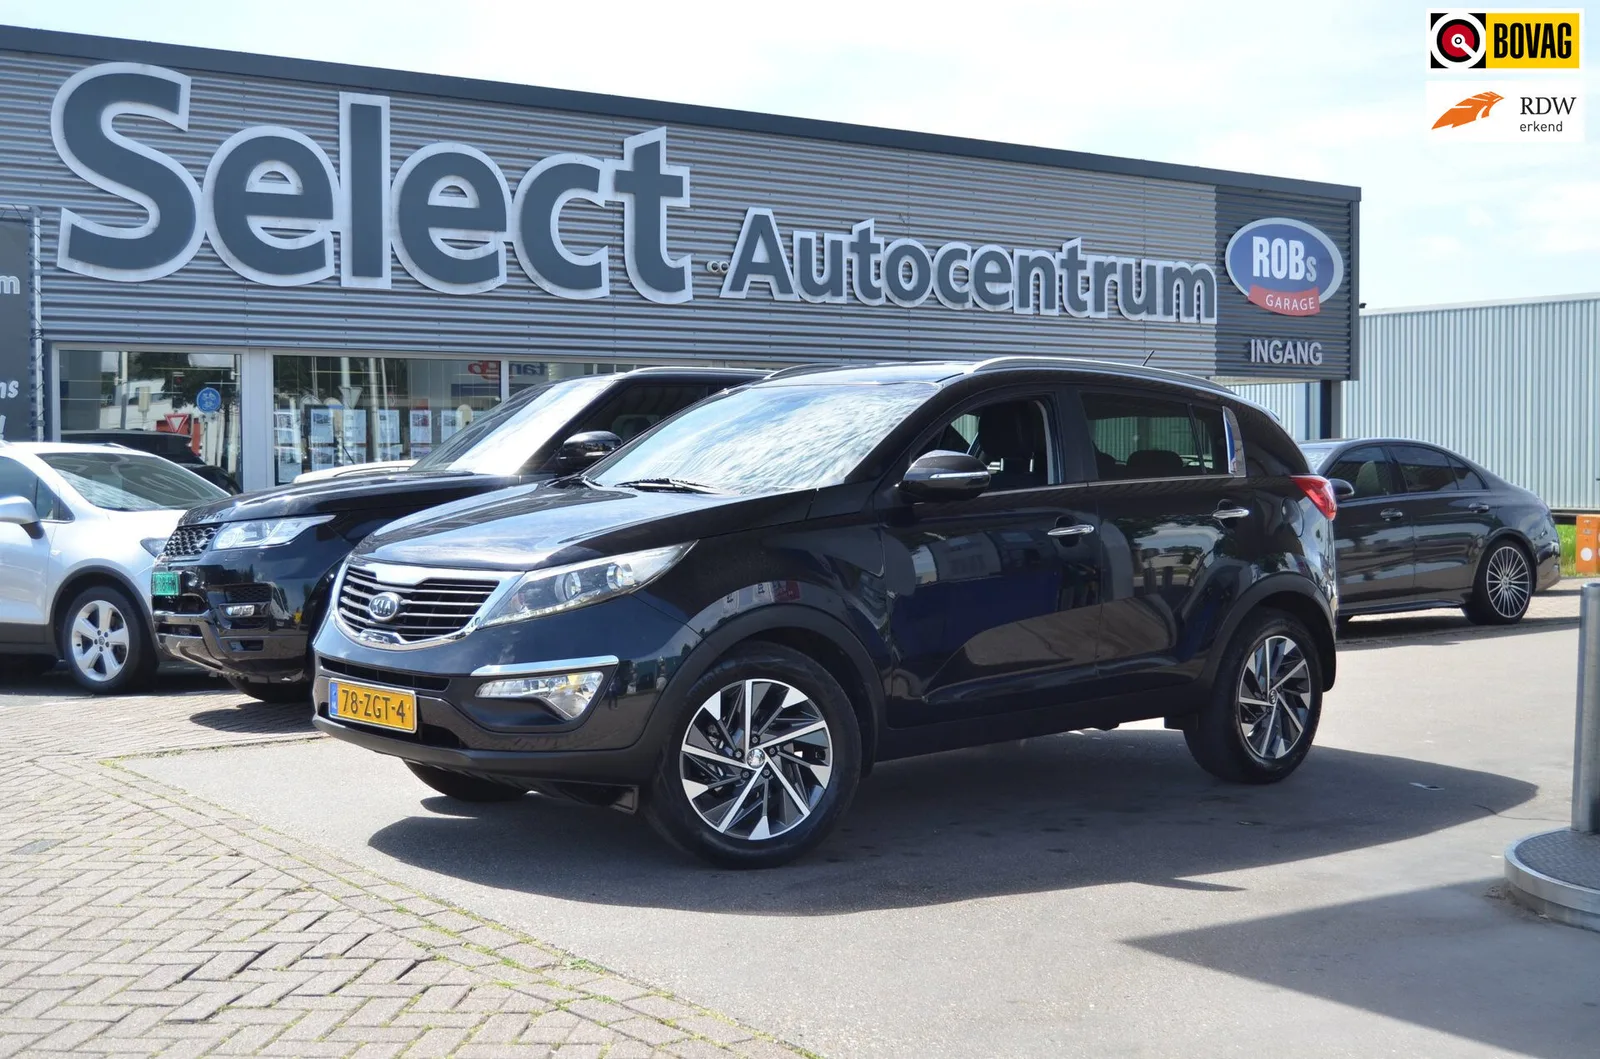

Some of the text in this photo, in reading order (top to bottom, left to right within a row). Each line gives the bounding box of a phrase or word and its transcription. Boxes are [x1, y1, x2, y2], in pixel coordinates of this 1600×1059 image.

[51, 62, 1218, 325] Select Autocentrum
[1265, 294, 1316, 311] GARAGE
[1250, 338, 1323, 365] INGANG
[341, 688, 407, 723] 78-ZGT-4
